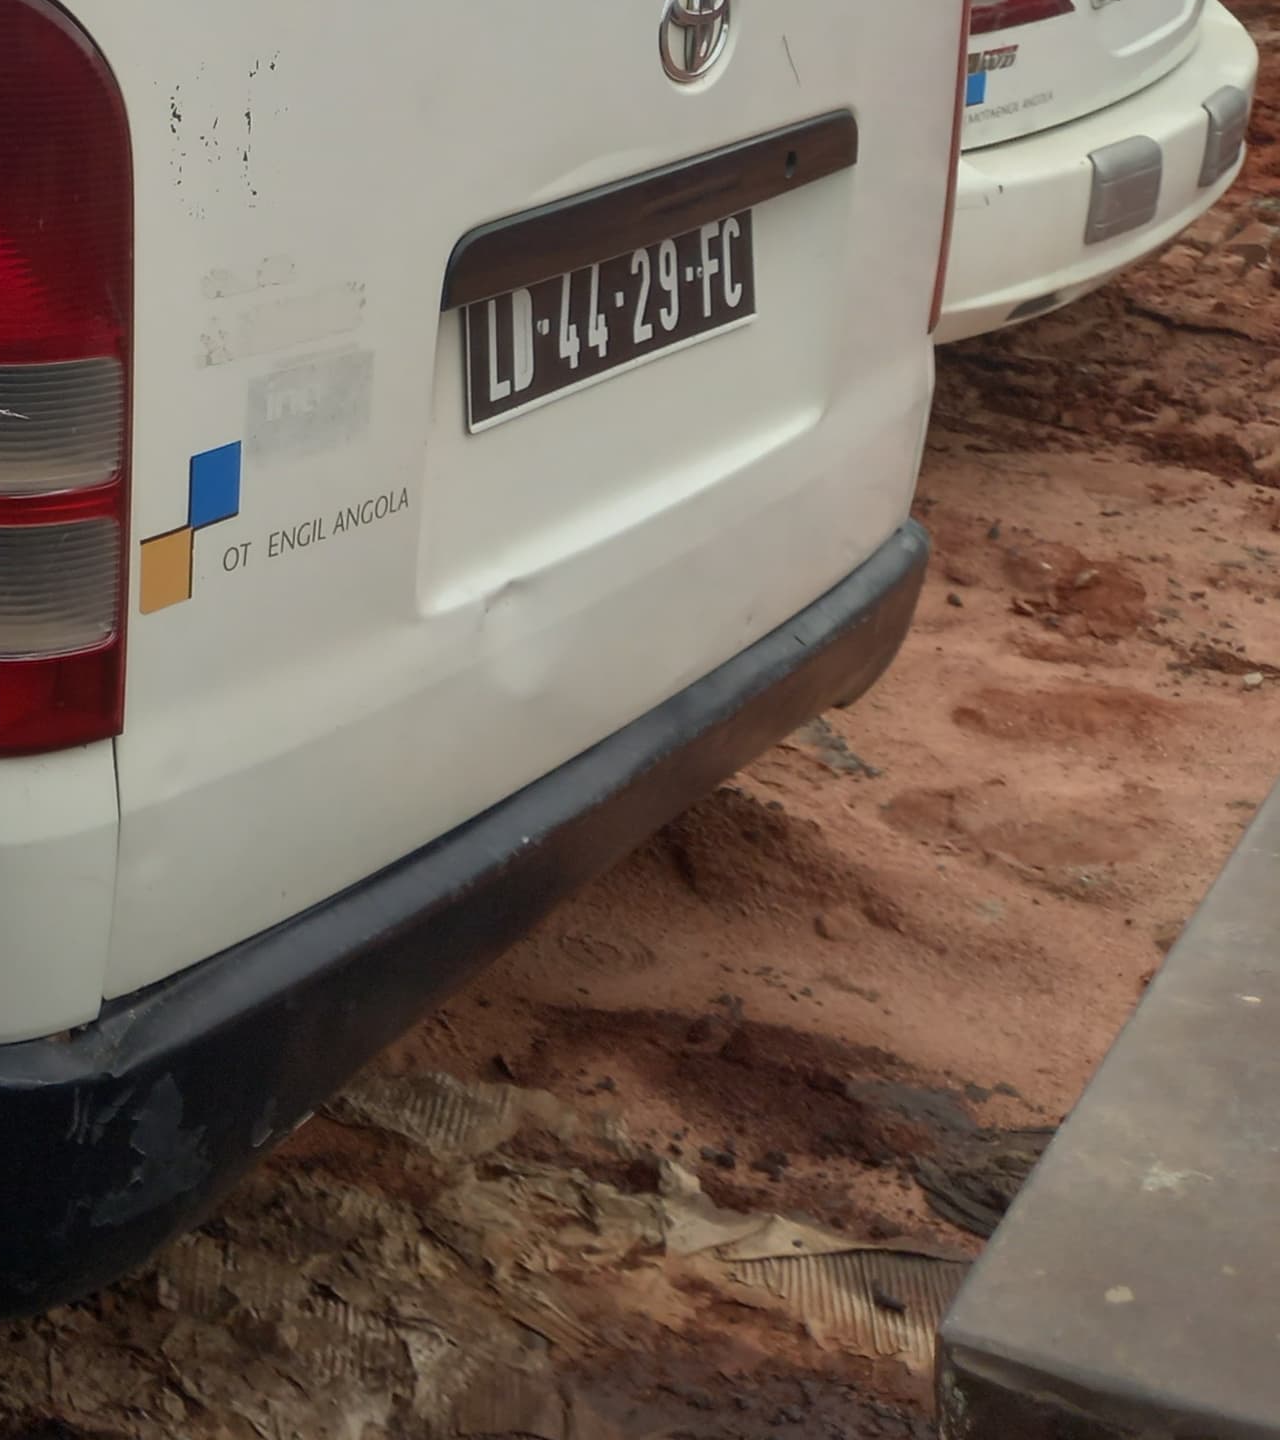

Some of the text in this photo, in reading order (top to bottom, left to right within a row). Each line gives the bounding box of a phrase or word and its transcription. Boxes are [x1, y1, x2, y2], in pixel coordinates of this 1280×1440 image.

[487, 217, 743, 402] LD-44-29-FC
[267, 517, 327, 558] ENGIL
[332, 487, 409, 536] ANGOLA
